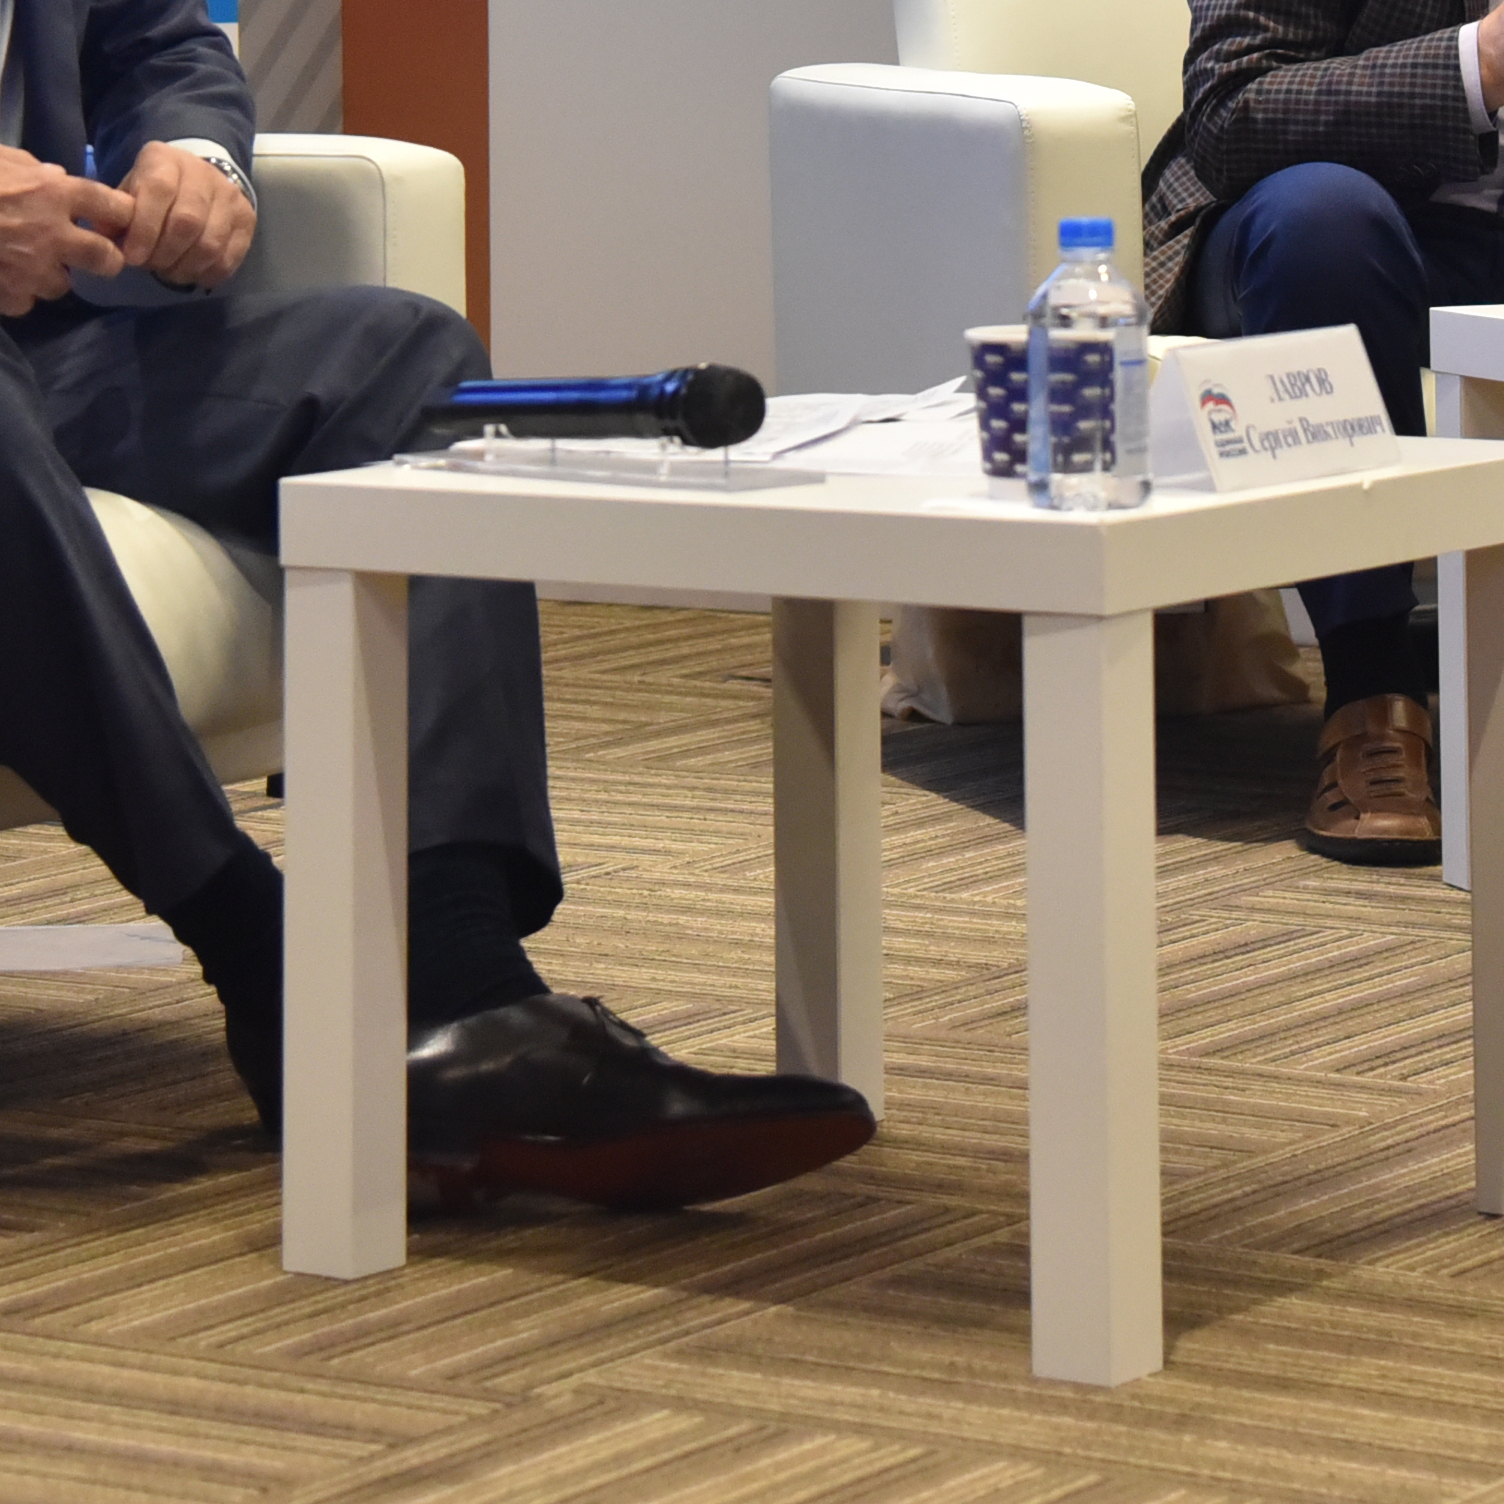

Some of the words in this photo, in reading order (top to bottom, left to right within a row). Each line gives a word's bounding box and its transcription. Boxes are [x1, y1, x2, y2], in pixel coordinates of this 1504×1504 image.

[1266, 367, 1335, 403] ЛАВРОВ
[1245, 418, 1302, 460] Сергей
[1298, 414, 1387, 447] Викторович
